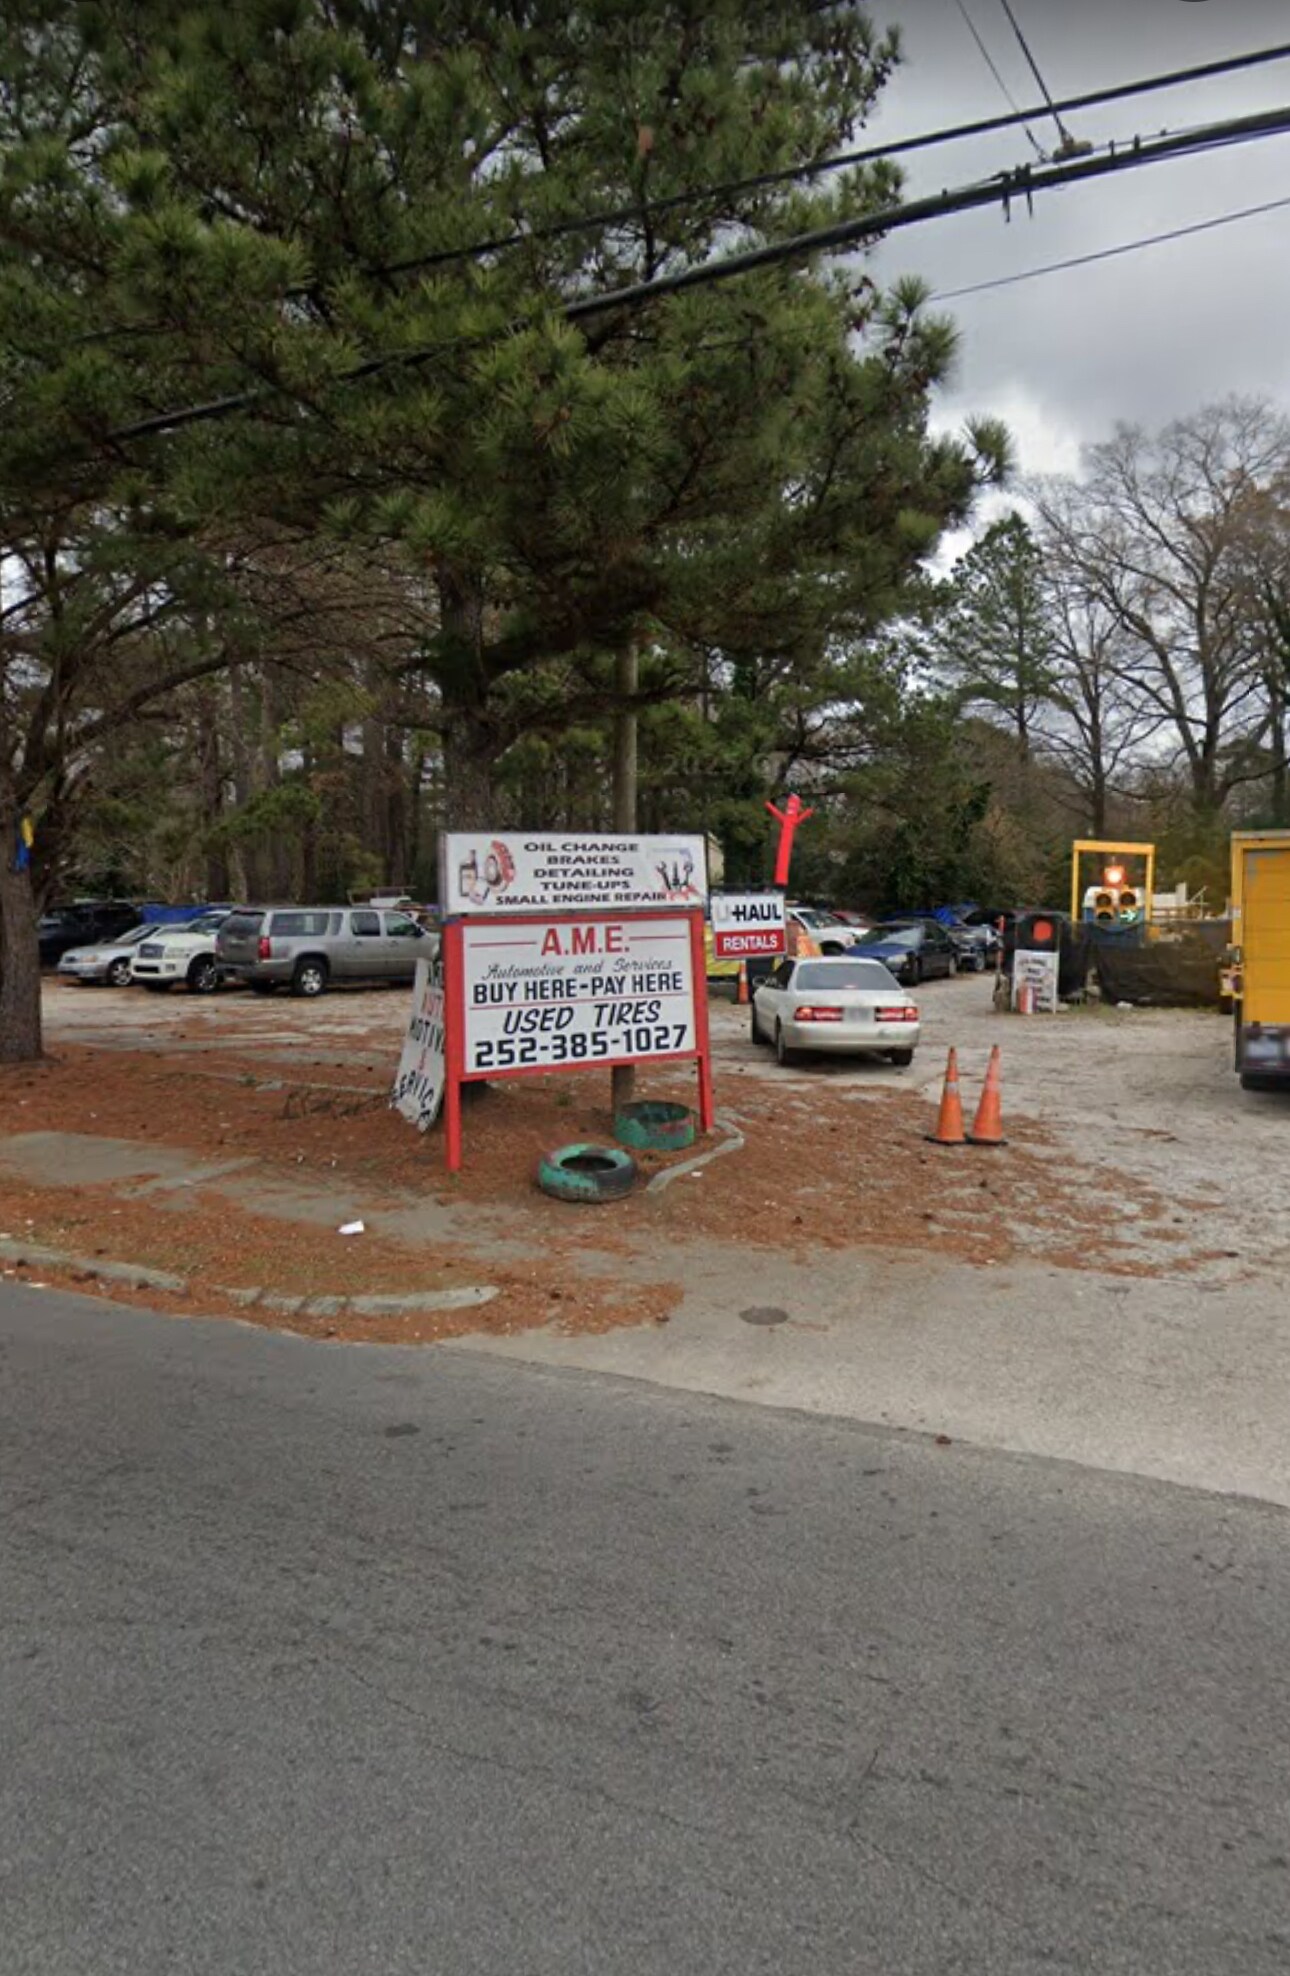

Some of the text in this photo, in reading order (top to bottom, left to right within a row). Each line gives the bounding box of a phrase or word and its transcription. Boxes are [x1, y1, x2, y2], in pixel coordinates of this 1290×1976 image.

[524, 842, 639, 852] OIL CHANGE
[547, 855, 620, 865] BRAKES
[533, 867, 634, 878] DETAILING
[540, 880, 631, 891] TUNE-UPS
[496, 891, 667, 906] SMALL ENGINE REPAIR
[541, 926, 630, 956] A.M.E.
[723, 933, 778, 952] RENTALS
[482, 957, 673, 980] Automotive and Services
[473, 982, 518, 1004] BUY
[632, 972, 683, 993] HERE
[503, 1000, 661, 1035] USED TIRES
[475, 1025, 687, 1068] 252-385-1027
